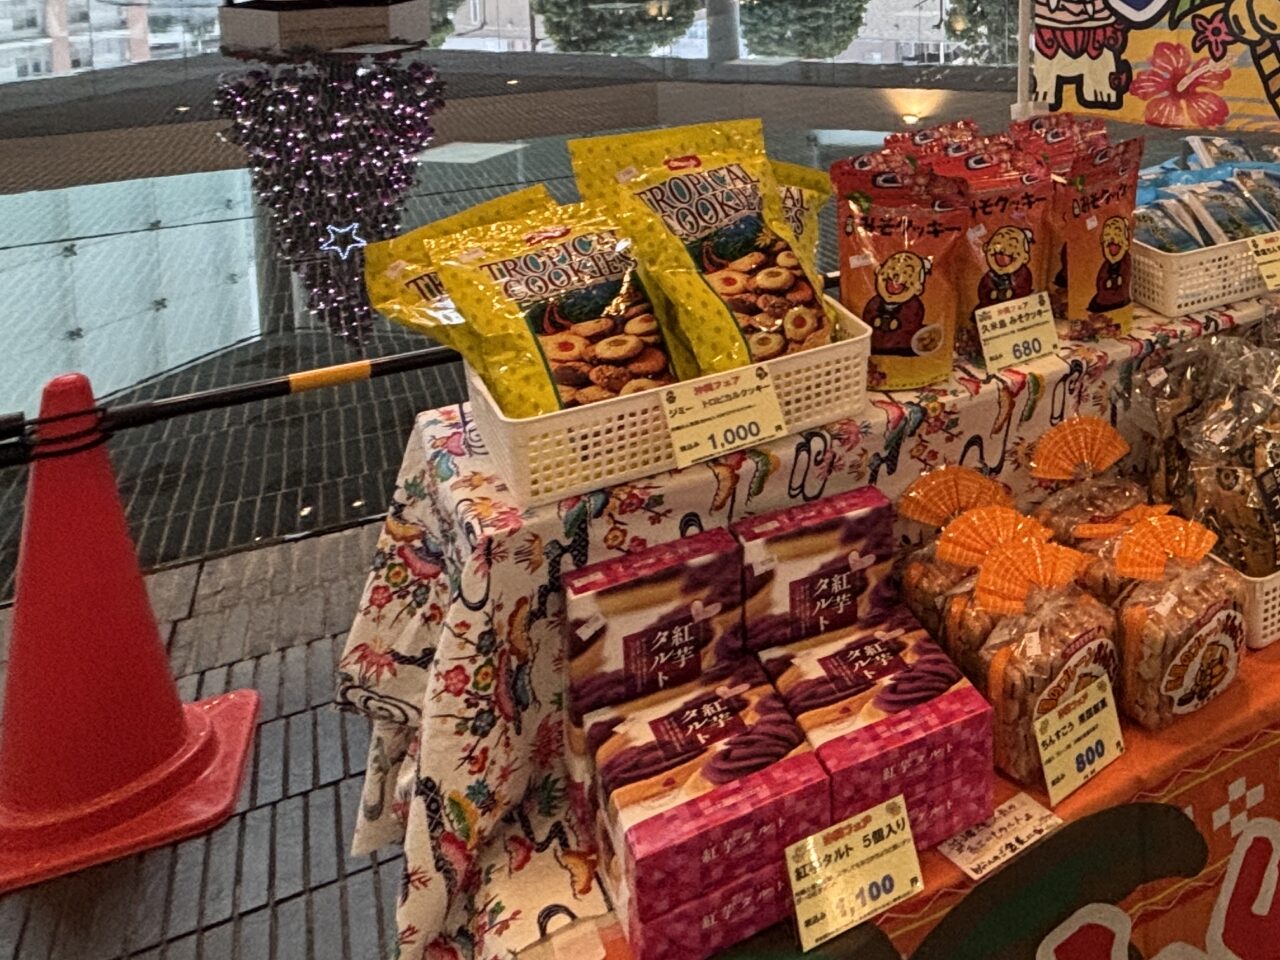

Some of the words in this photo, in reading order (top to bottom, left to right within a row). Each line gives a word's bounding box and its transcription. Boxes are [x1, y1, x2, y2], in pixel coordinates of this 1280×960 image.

[634, 163, 761, 214] TROPICAL
[1012, 338, 1042, 359] 680
[668, 406, 694, 419] ジミー
[707, 421, 761, 450] 1,000
[811, 578, 834, 631] タルト
[649, 631, 675, 688] タルト
[1075, 739, 1106, 773] 800
[861, 816, 906, 849] 5個入り
[836, 874, 895, 918] 1,100
